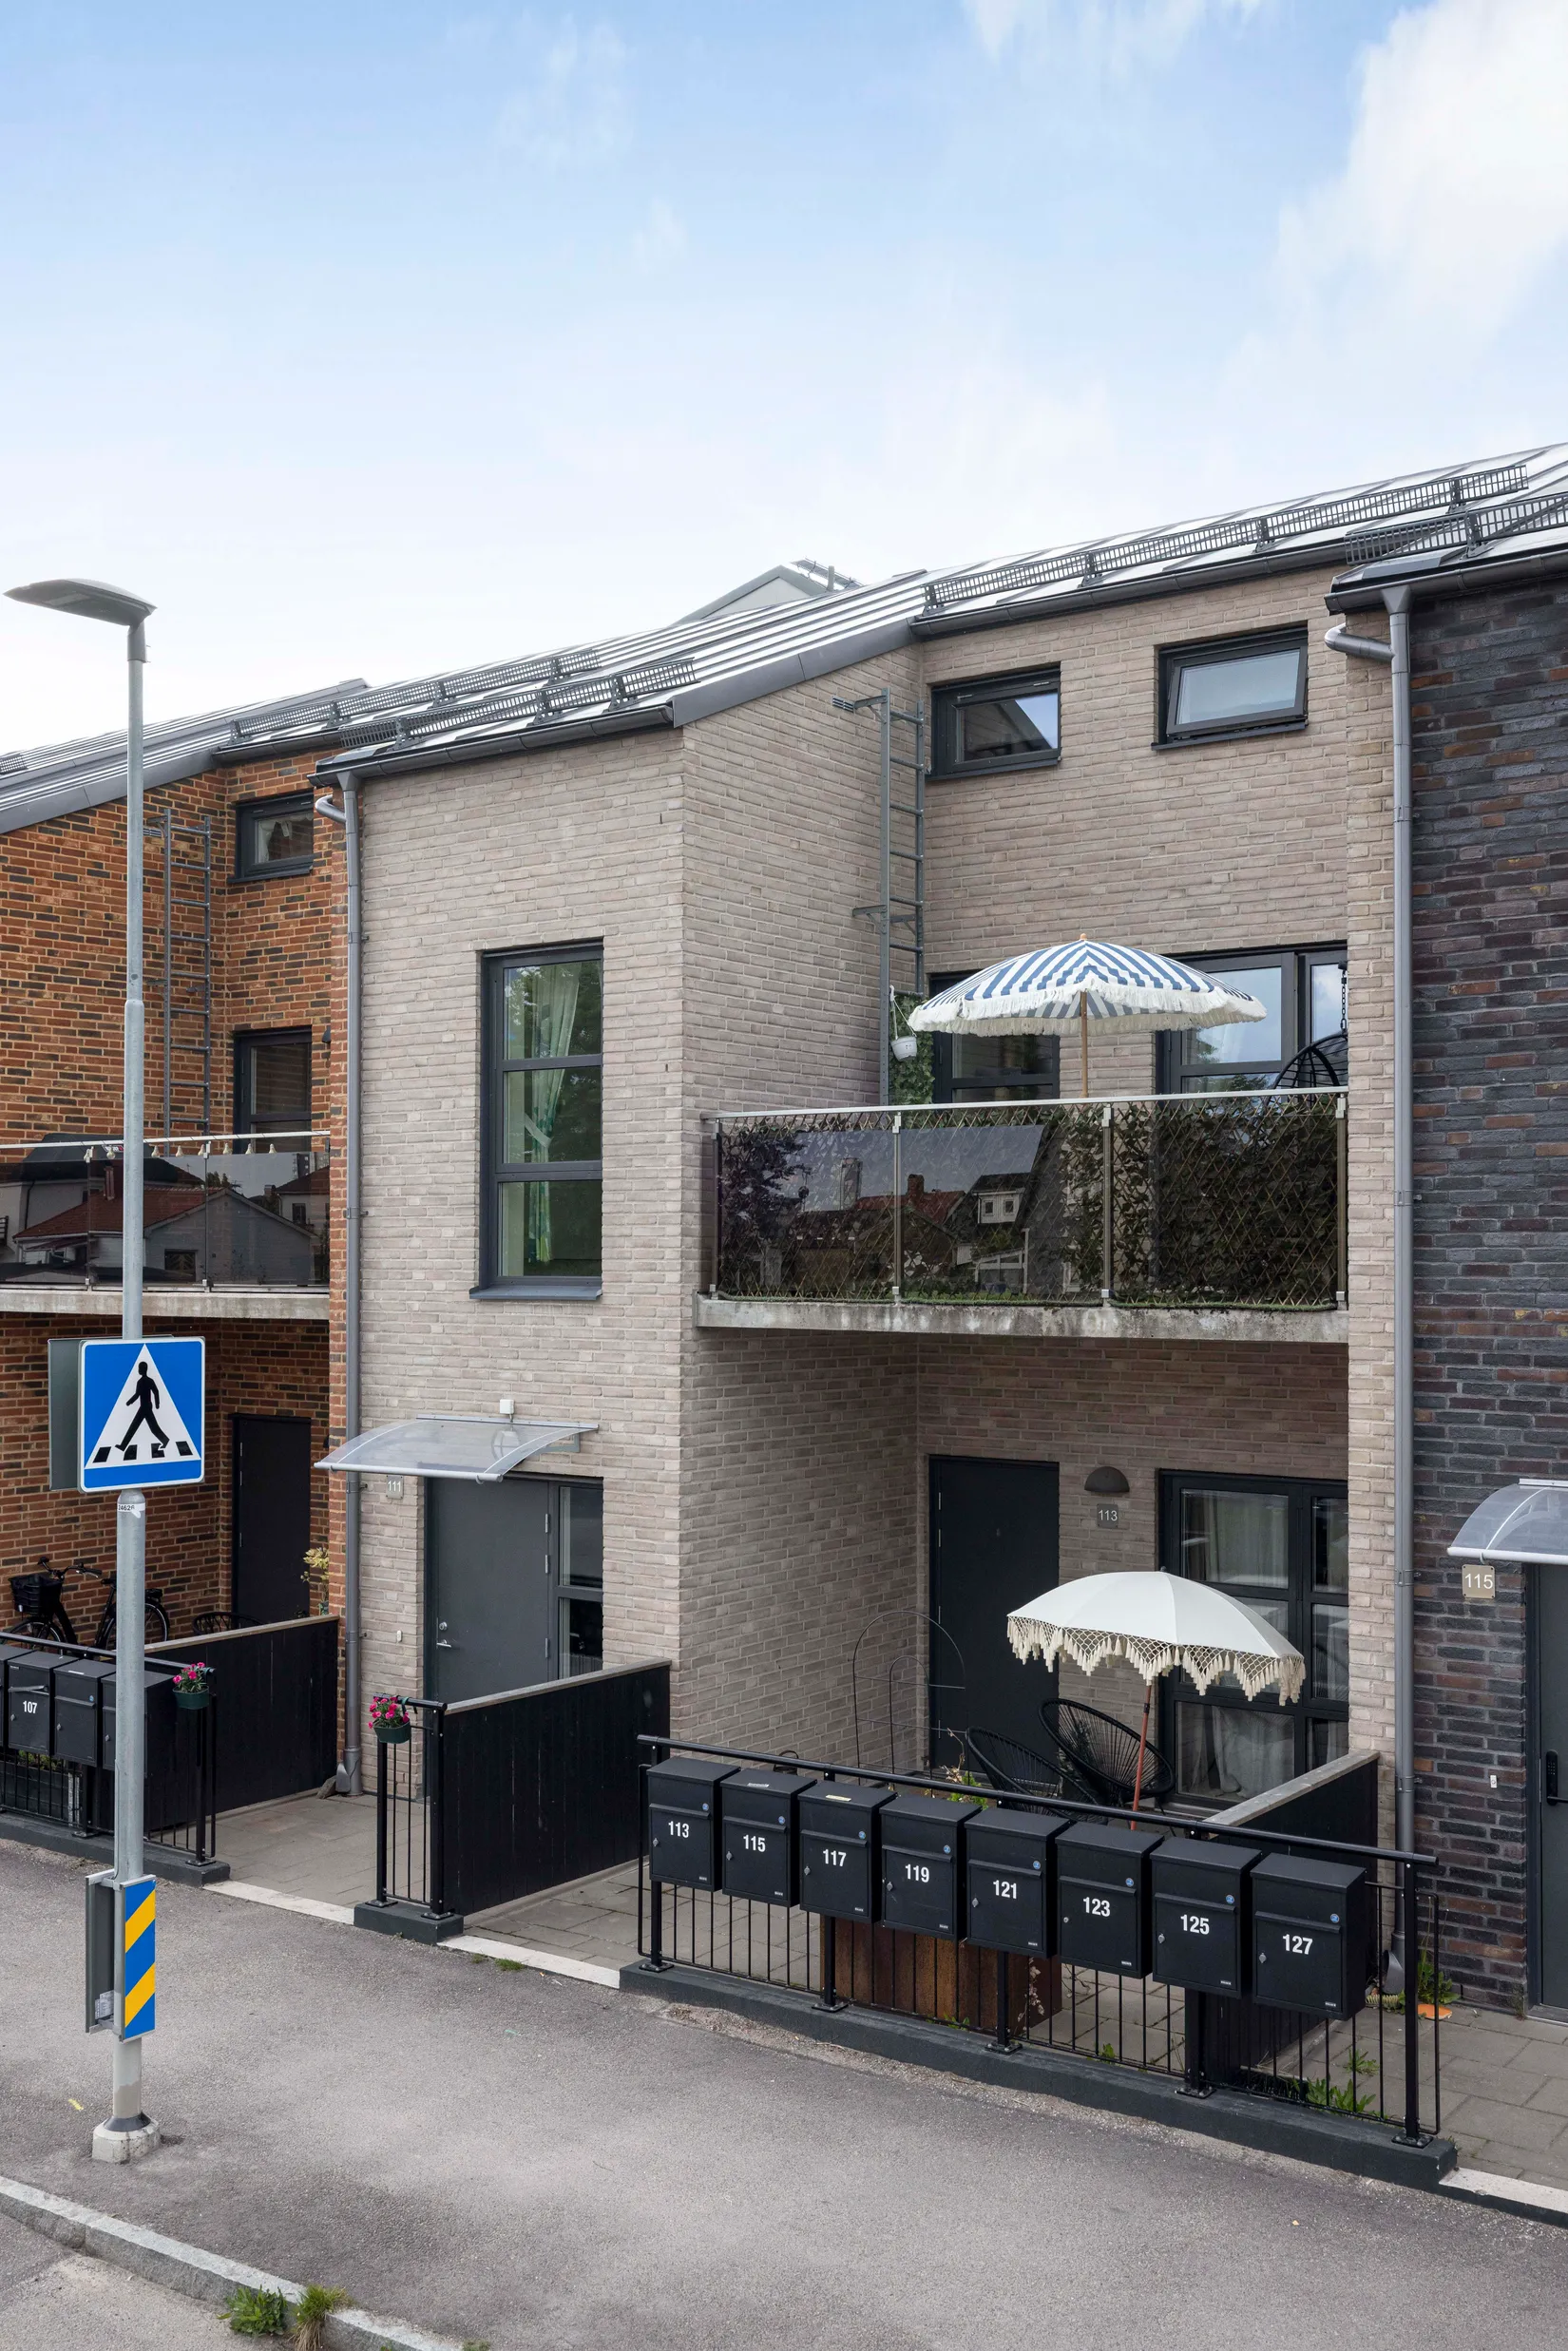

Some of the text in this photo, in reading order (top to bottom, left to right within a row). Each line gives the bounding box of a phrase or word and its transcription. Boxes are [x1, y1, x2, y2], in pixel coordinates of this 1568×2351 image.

[387, 1480, 401, 1492] 111
[1098, 1509, 1118, 1521] 113
[1464, 1573, 1494, 1590] 115
[22, 1700, 38, 1714] 107
[668, 1820, 690, 1839] 113
[742, 1834, 766, 1853] 115
[822, 1848, 847, 1867] 117
[905, 1864, 930, 1883] 119
[992, 1879, 1017, 1900] 121
[1082, 1896, 1111, 1918] 123
[1179, 1914, 1210, 1936] 125
[1282, 1933, 1313, 1956] 127
